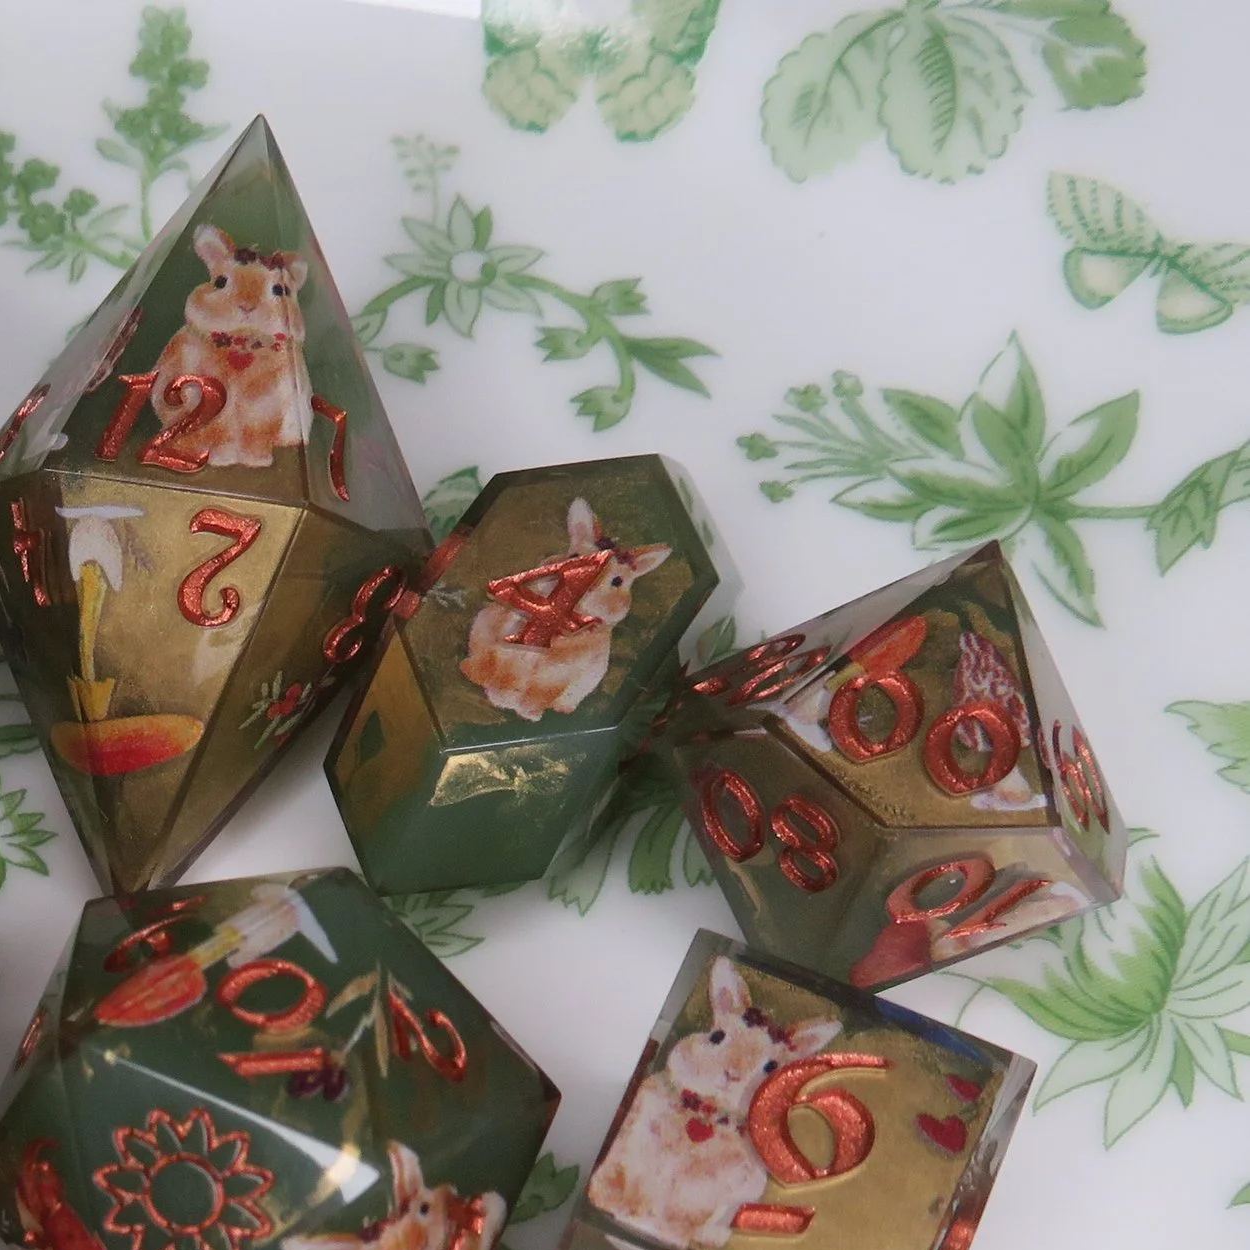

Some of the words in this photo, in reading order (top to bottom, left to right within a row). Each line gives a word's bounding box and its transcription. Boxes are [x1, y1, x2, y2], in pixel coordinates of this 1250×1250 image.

[94, 369, 228, 473] 12
[311, 394, 351, 502] 7
[176, 508, 262, 628] 2
[487, 548, 611, 650] 4
[828, 668, 1022, 798] 00
[749, 1050, 894, 1188] 6
